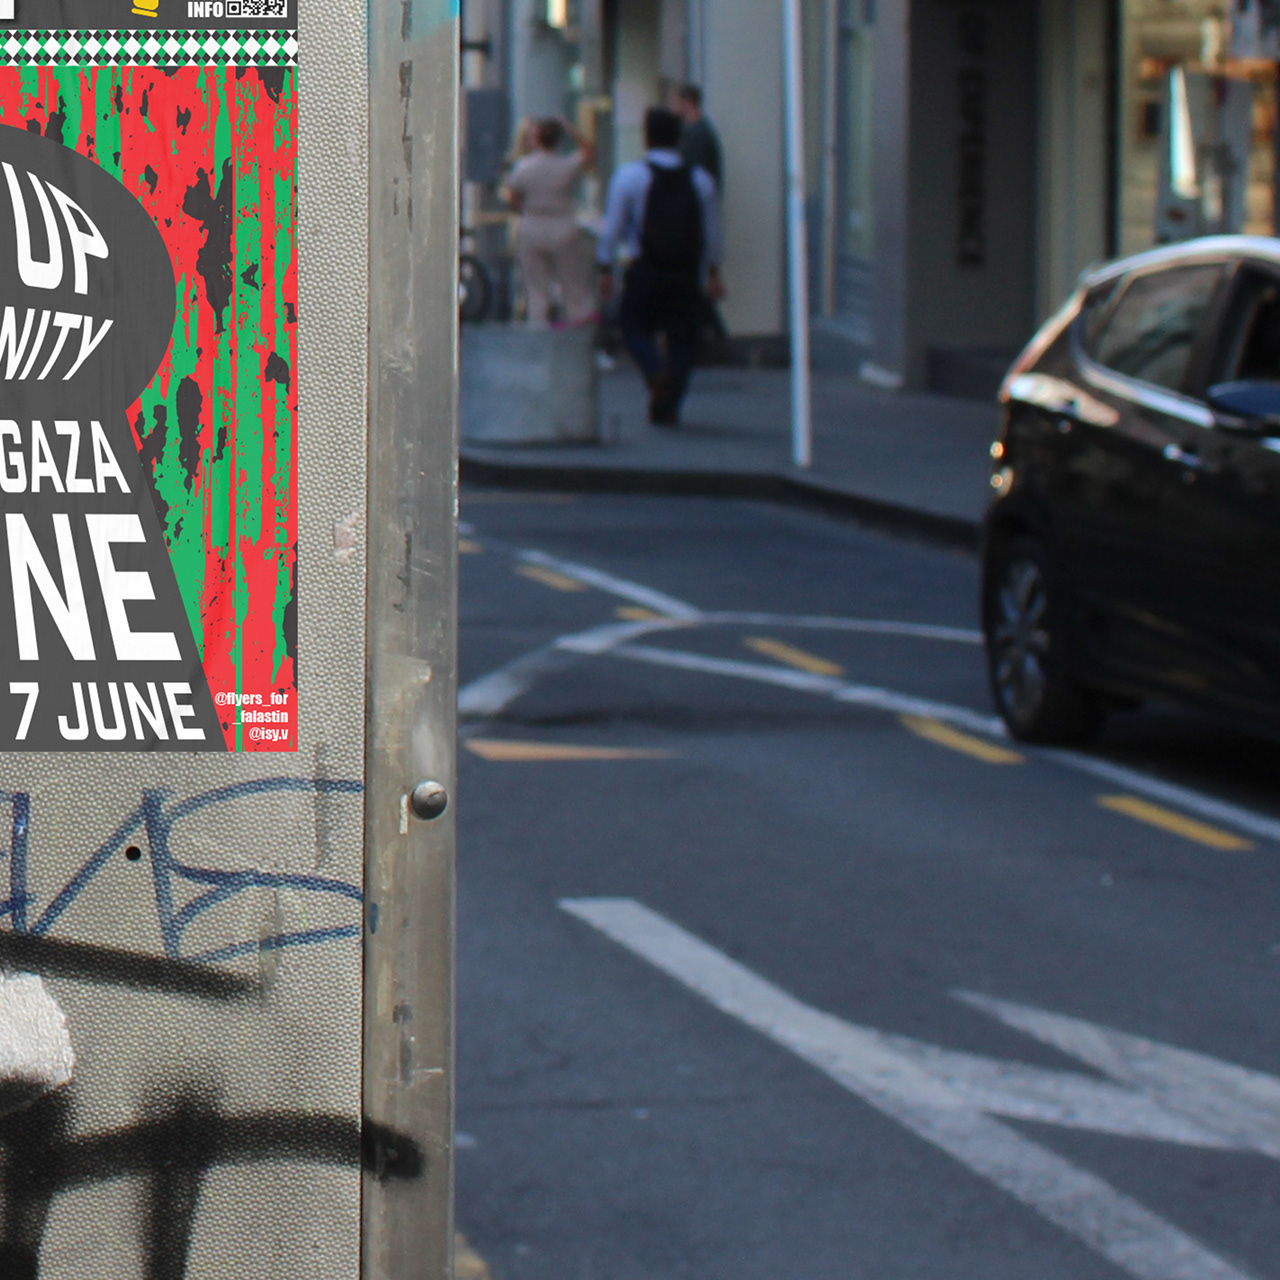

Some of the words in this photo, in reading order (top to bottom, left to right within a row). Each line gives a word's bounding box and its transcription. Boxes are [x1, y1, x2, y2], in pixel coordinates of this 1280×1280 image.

[187, 1, 224, 18] INFO
[2, 161, 109, 295] UP
[214, 691, 289, 707] @flyers_for
[8, 681, 40, 741] 7
[57, 681, 207, 741] JUNE
[248, 726, 289, 742] @isy.v
